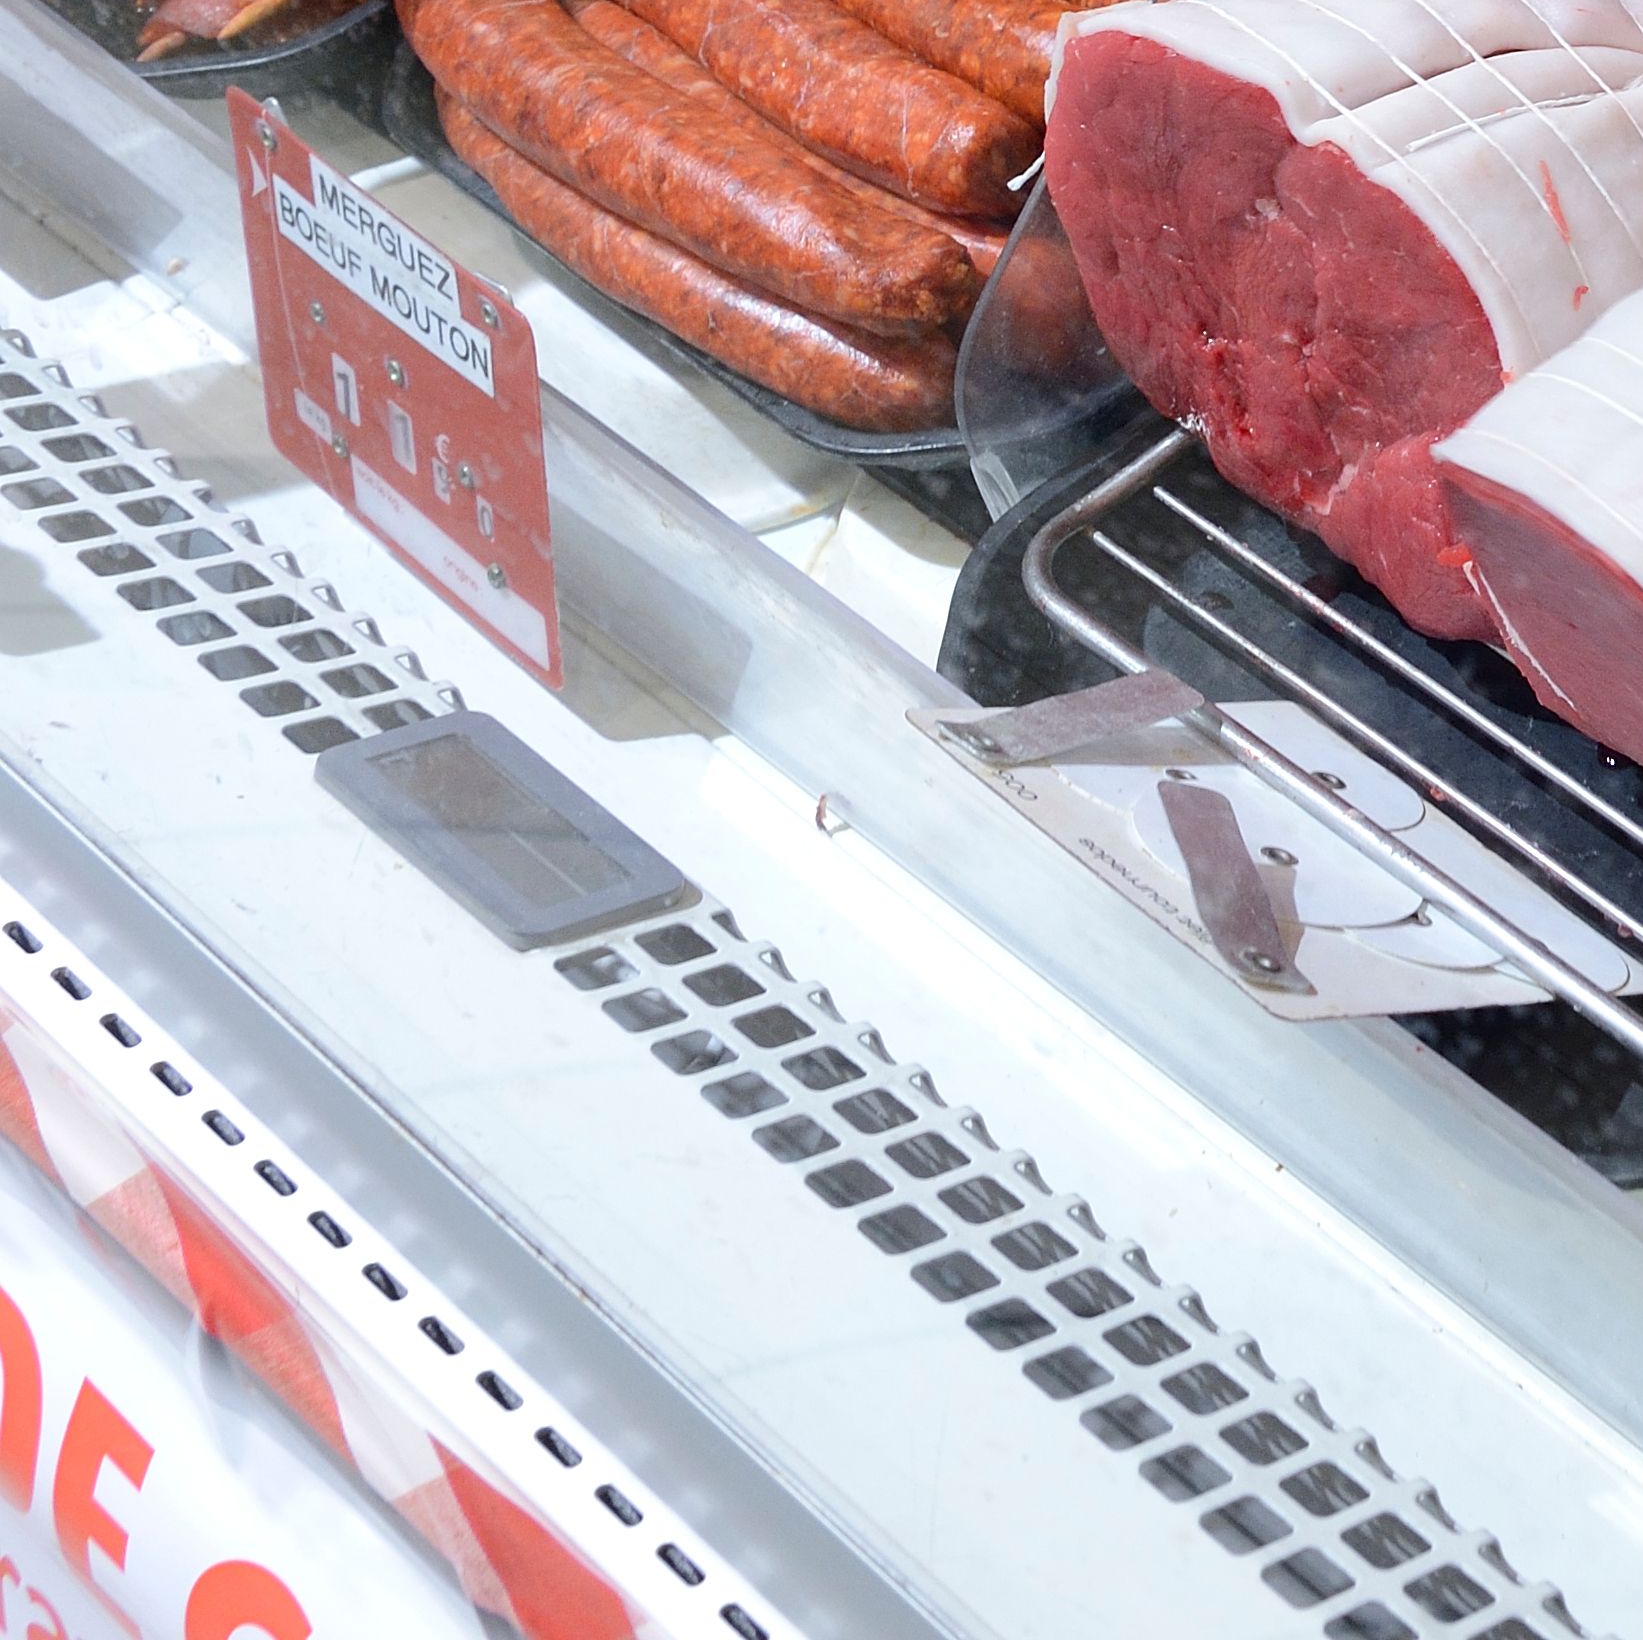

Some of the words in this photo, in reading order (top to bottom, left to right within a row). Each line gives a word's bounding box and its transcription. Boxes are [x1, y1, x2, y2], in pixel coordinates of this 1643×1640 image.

[288, 190, 362, 279] BOEUF
[370, 264, 490, 380] MOUTON
[318, 173, 454, 302] MERGUEZ
